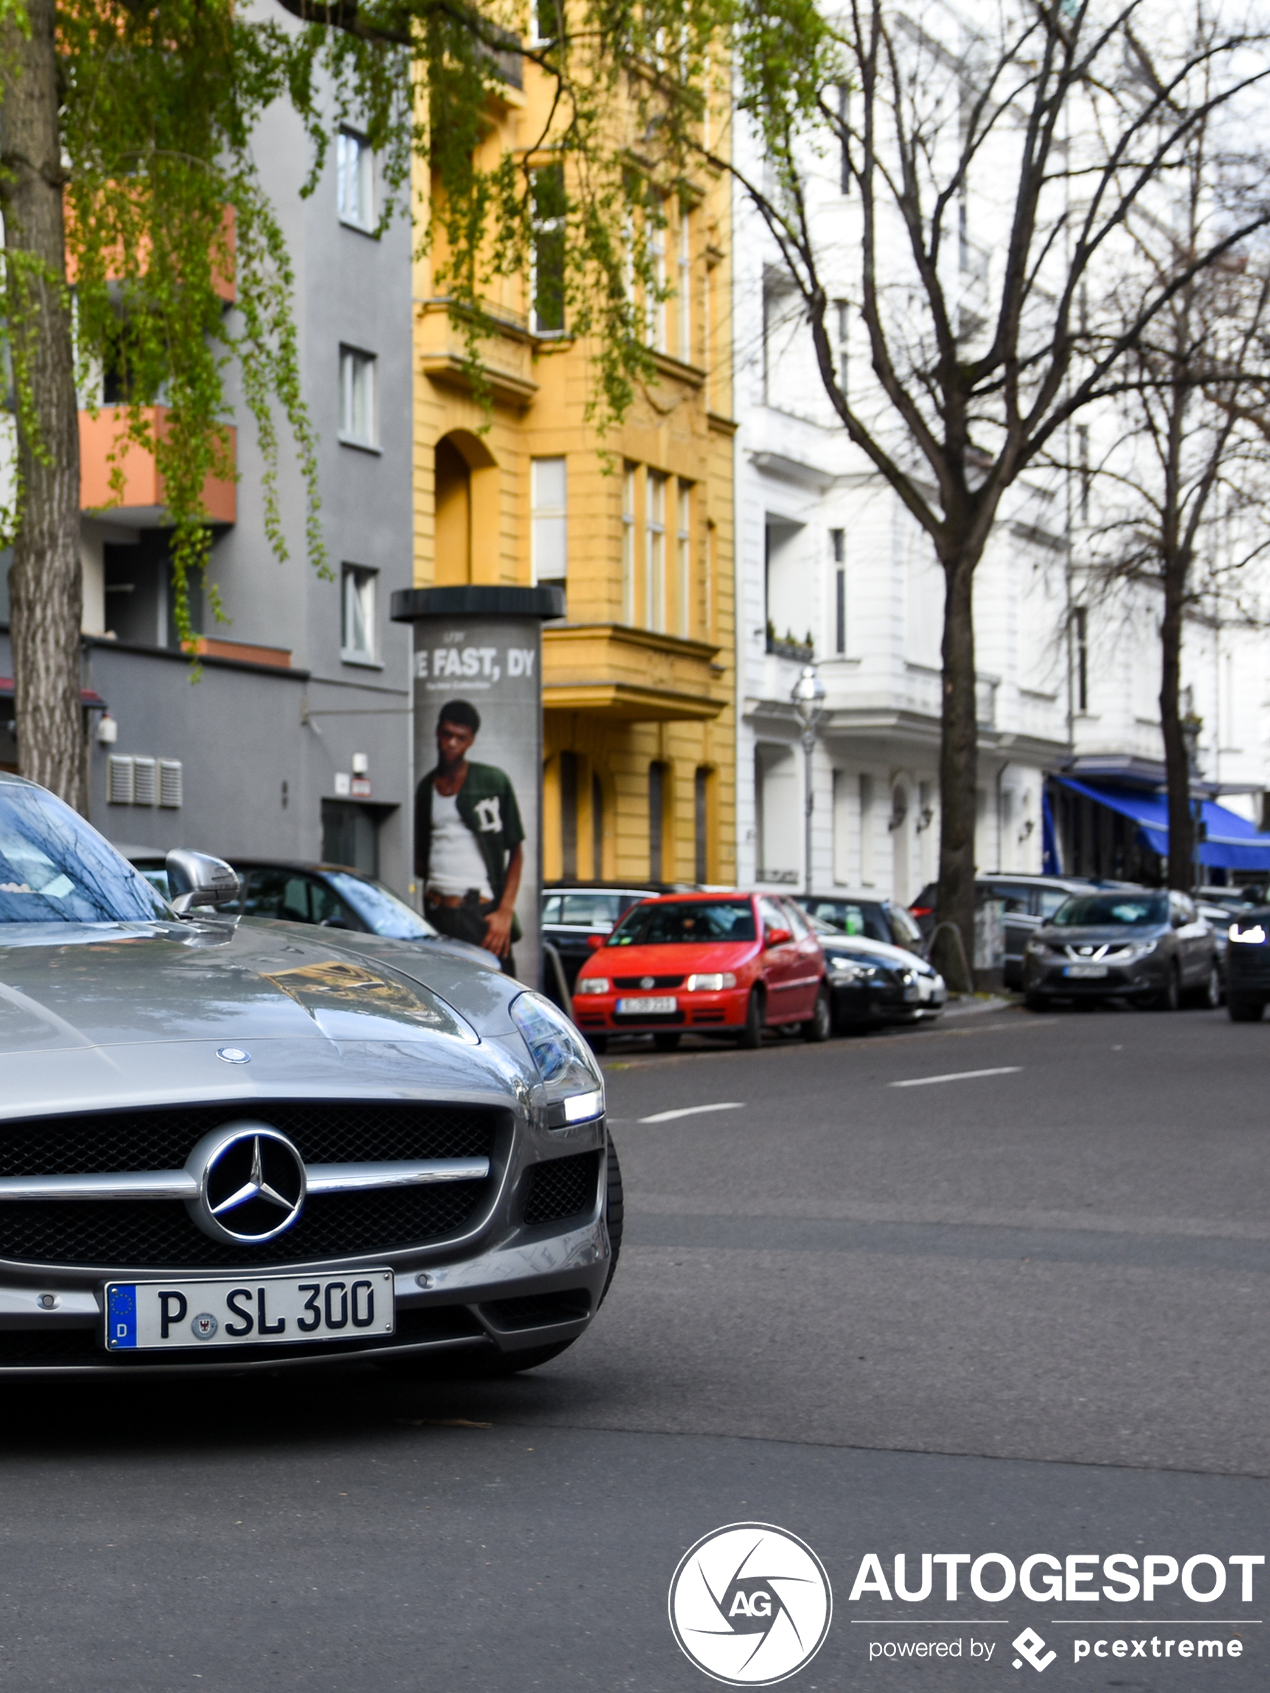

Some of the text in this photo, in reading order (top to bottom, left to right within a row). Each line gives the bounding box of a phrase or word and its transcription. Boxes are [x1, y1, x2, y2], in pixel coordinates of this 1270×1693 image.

[433, 647, 501, 682] FAST,
[157, 1279, 375, 1339] P SL 300
[117, 1323, 127, 1337] D
